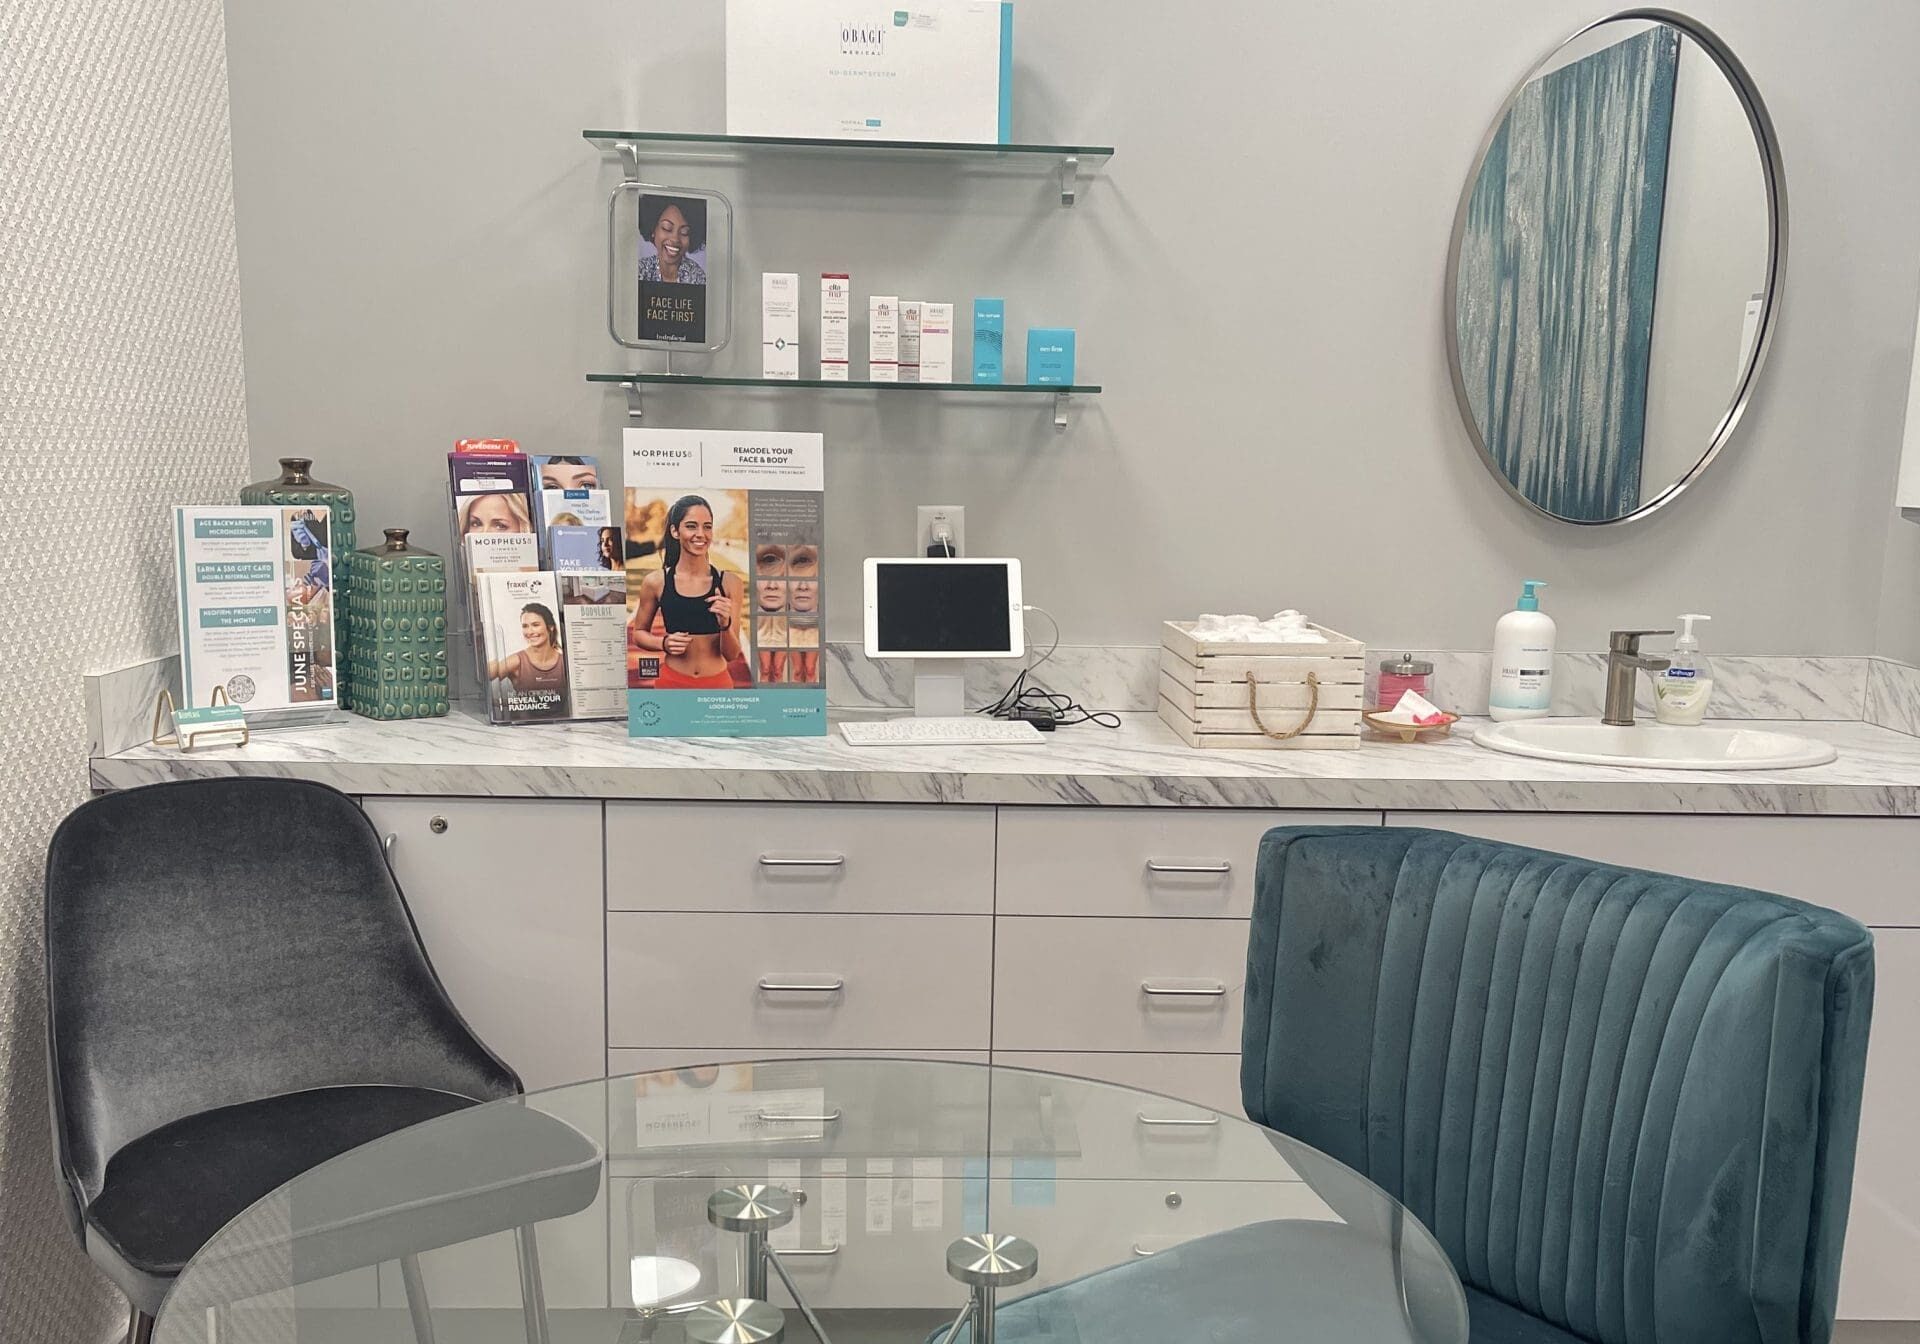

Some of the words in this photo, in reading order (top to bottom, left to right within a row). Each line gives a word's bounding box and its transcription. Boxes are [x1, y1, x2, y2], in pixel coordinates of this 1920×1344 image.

[842, 29, 881, 44] OBAGI
[651, 296, 673, 309] FACE
[674, 298, 693, 310] LIFE
[647, 308, 668, 321] FACE
[670, 310, 695, 322] FIRST
[733, 446, 771, 455] REMODEL
[771, 447, 794, 455] YOUR
[739, 455, 758, 463] FACE
[766, 456, 789, 464] BODY
[559, 559, 581, 567] TAKE
[197, 565, 216, 573] EARN
[506, 580, 529, 590] fraxel
[233, 608, 261, 616] PRODUCT
[291, 577, 305, 649] SPECIALS
[293, 653, 307, 693] JUNE
[507, 696, 538, 704] REVEAL
[538, 694, 561, 702] YOUR
[508, 702, 550, 711] RADIANCE.
